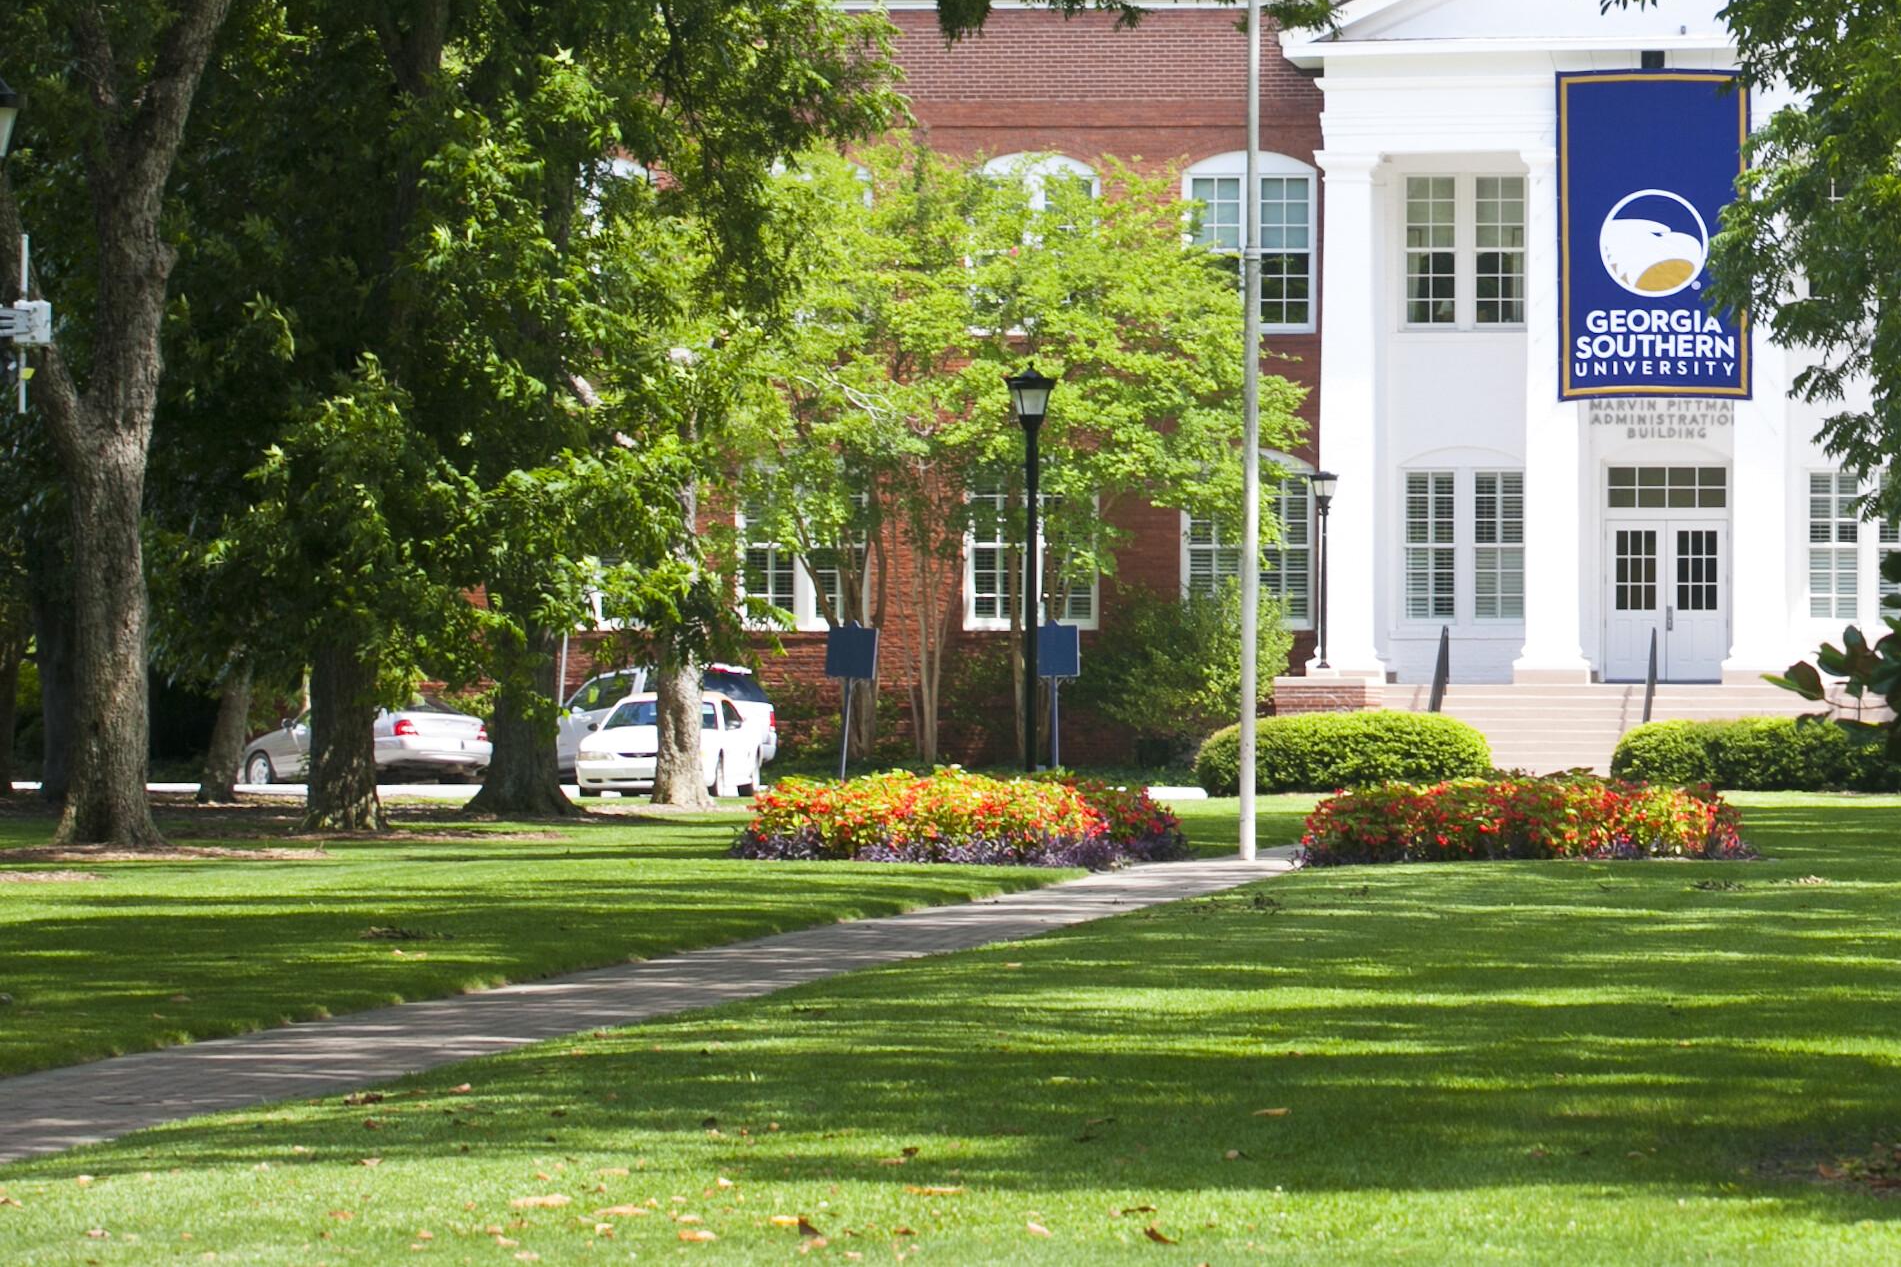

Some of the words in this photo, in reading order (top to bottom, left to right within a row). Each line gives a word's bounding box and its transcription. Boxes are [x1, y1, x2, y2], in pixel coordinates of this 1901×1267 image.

[1585, 309, 1723, 334] GEORGIA
[1575, 334, 1735, 360] SOUTHERN
[1575, 360, 1735, 377] UNIVERSITY
[1589, 399, 1657, 411] MARVIN
[1667, 399, 1735, 412] PITTMA
[1591, 413, 1735, 426] ADMINISTRATIO
[1626, 427, 1707, 439] BUILDING
